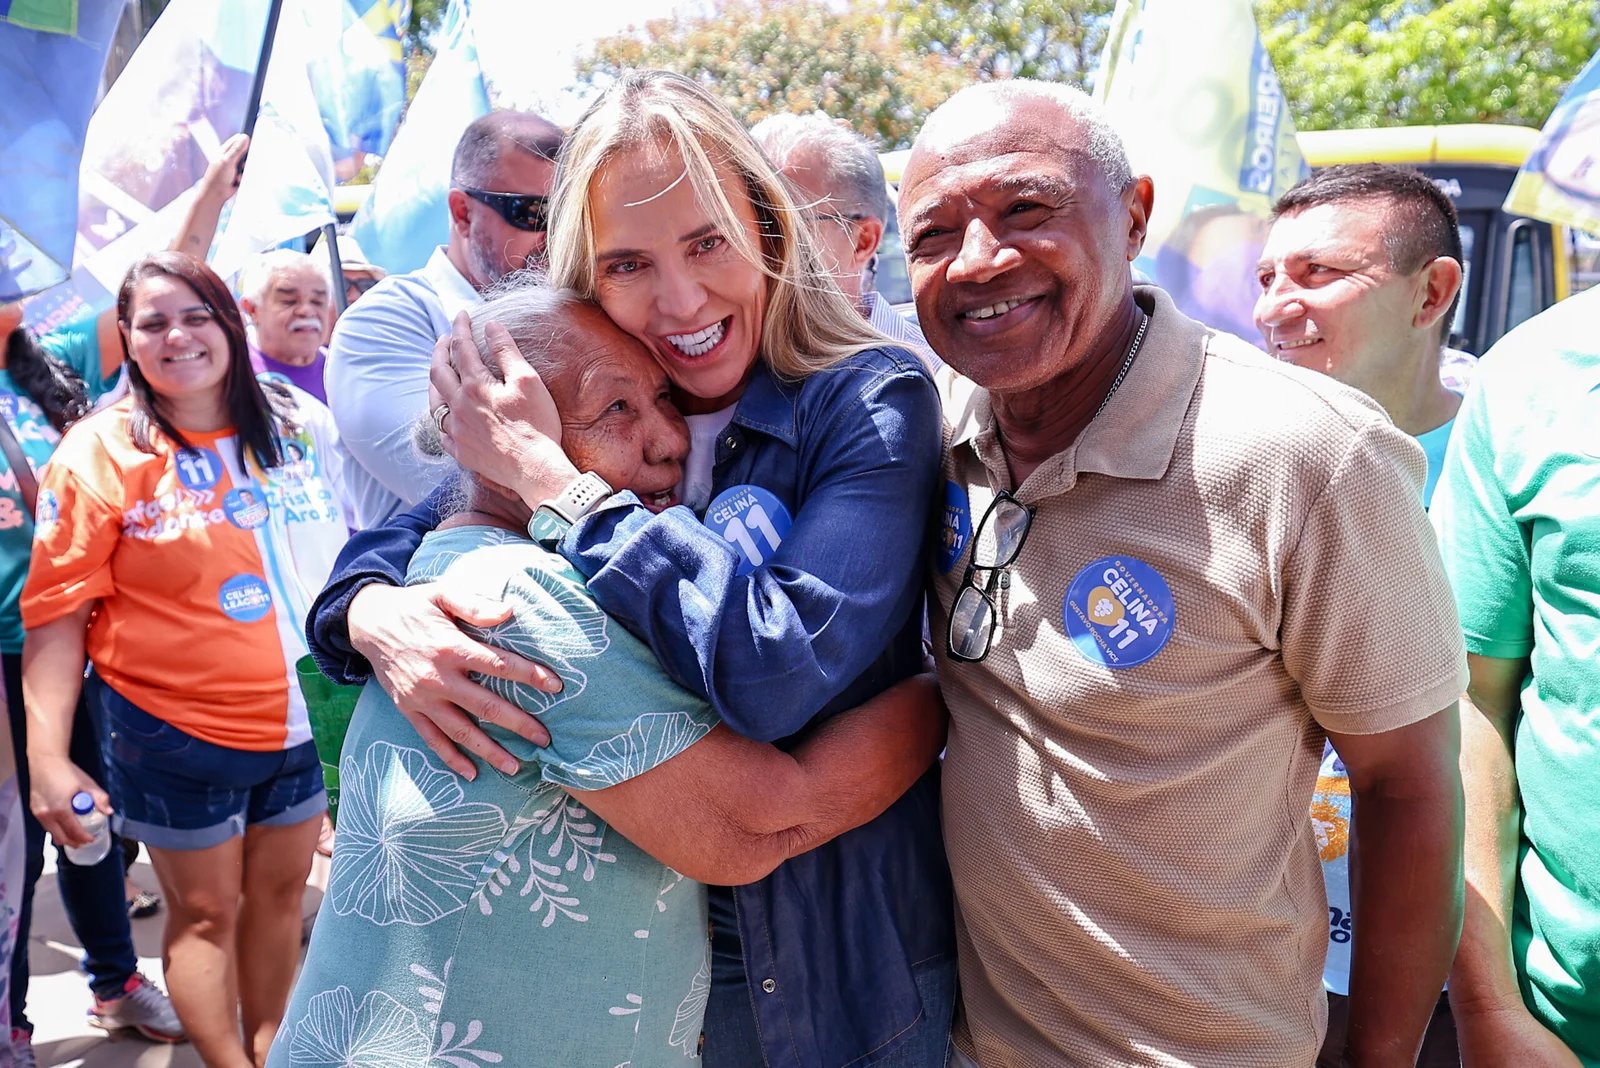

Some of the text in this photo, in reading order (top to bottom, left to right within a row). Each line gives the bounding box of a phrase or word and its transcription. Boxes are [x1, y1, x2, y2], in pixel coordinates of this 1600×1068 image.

[180, 458, 215, 485] 11
[713, 493, 758, 525] CELINA
[723, 504, 783, 567] 11
[225, 586, 263, 600] CELINA
[1102, 567, 1159, 636] CELINA
[1115, 560, 1169, 625] GOVERNADORA
[1069, 600, 1120, 664] GUSTAVO ROCHA VICE
[1108, 618, 1139, 650] 11
